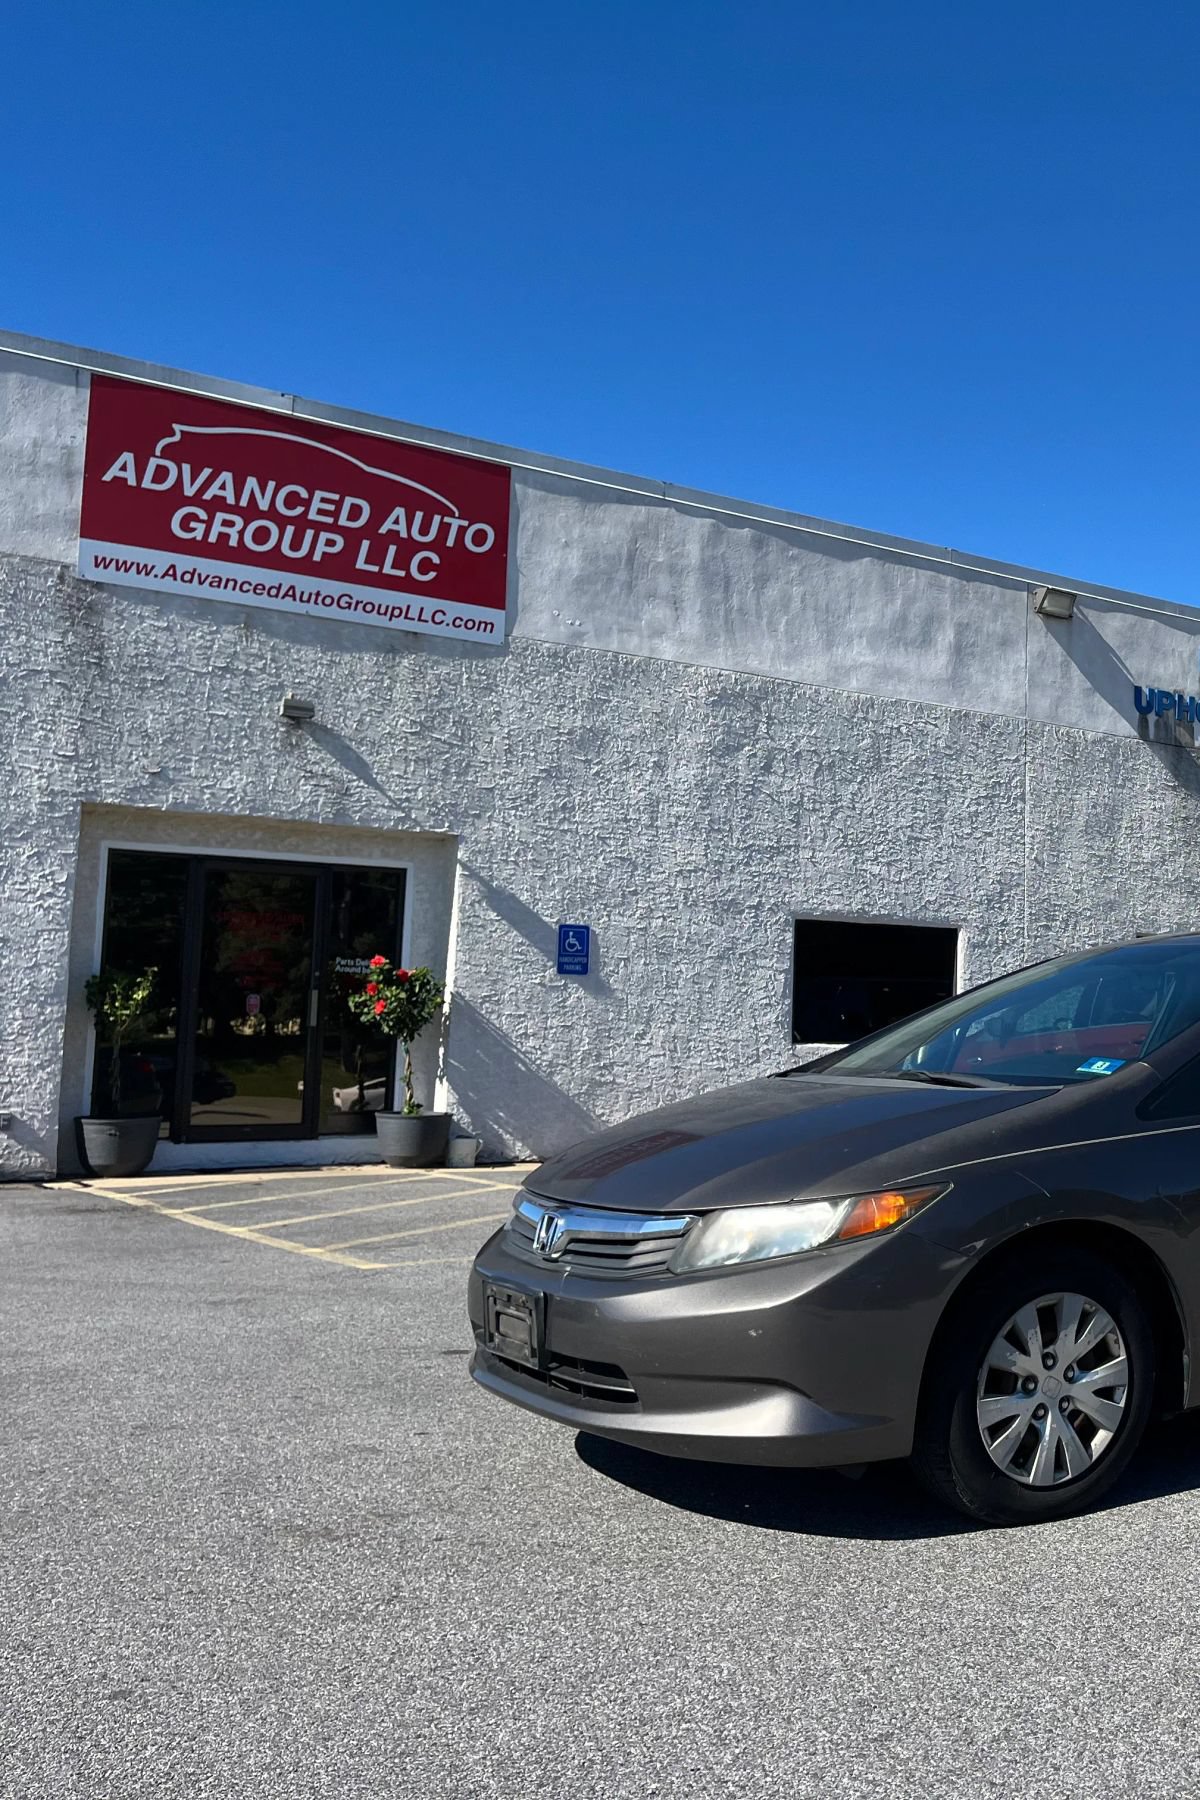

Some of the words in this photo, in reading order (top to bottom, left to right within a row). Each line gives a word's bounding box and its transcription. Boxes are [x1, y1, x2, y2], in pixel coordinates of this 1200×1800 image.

[102, 451, 371, 529] ADVANCED
[379, 506, 496, 554] AUTO
[170, 505, 345, 562] GROUP
[355, 539, 441, 583] LLC
[93, 553, 495, 634] www.AdvancedAutoGroupLLC.com
[335, 965, 360, 973] Around
